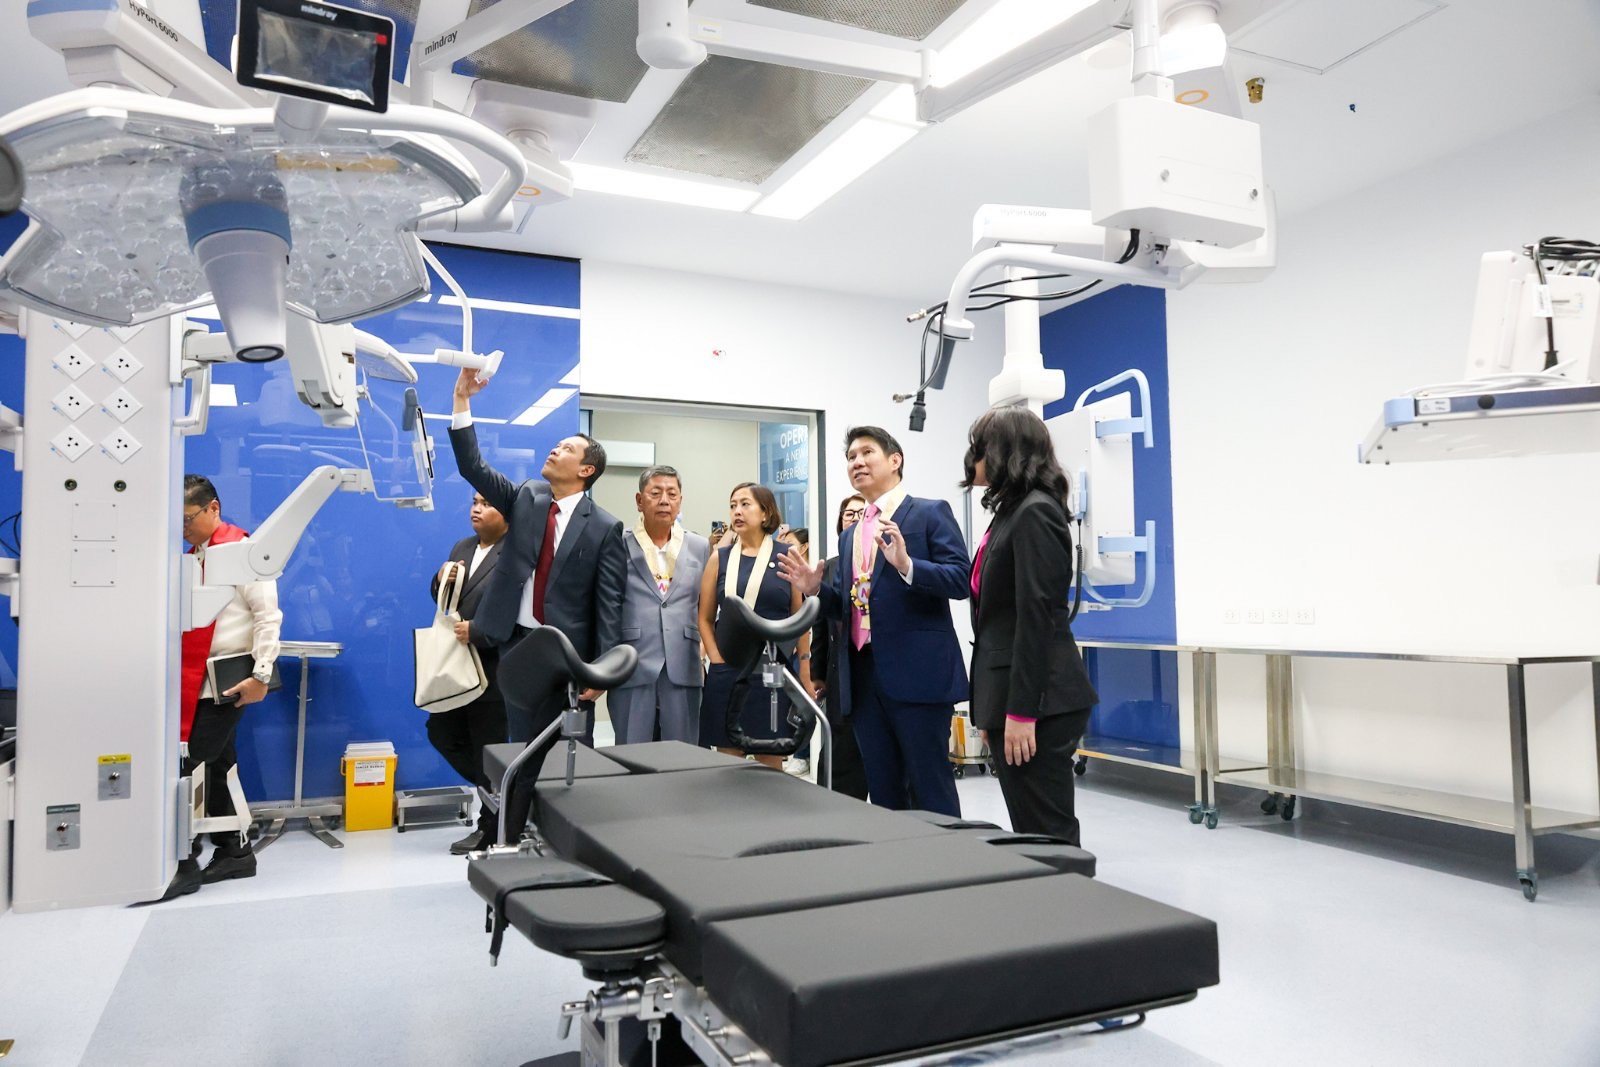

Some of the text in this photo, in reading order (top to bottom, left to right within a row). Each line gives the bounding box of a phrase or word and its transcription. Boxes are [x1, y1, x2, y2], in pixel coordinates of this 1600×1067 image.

[300, 4, 338, 21] mindray
[424, 30, 458, 56] mindray
[785, 451, 791, 463] A
